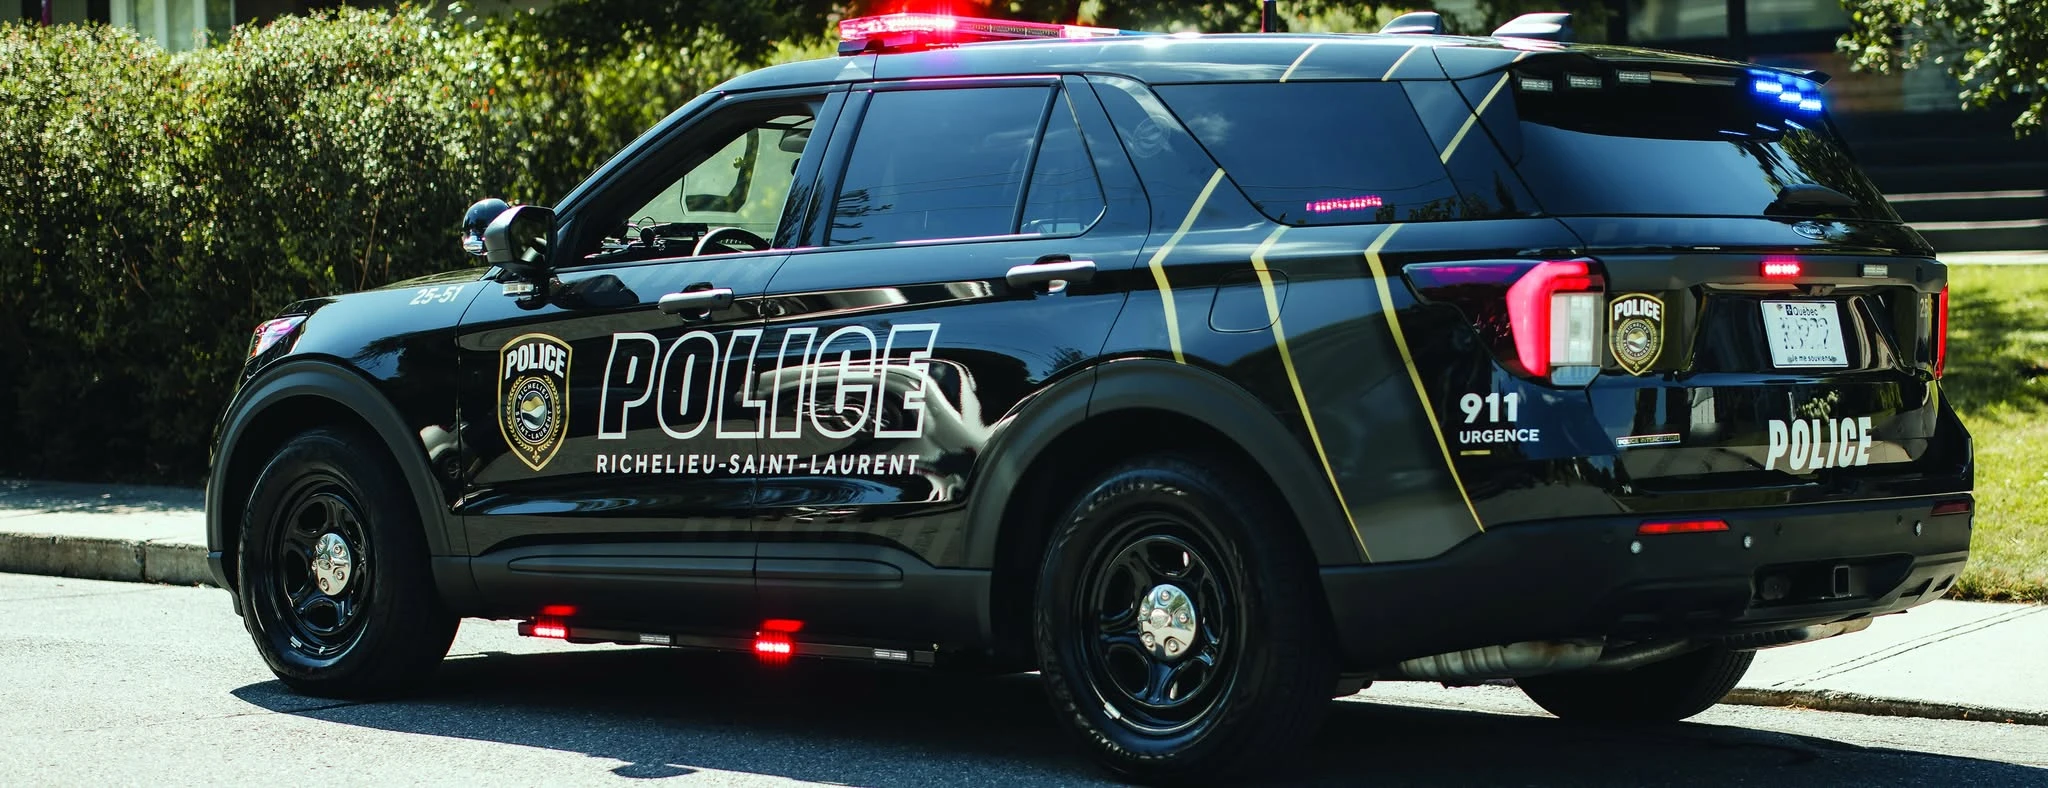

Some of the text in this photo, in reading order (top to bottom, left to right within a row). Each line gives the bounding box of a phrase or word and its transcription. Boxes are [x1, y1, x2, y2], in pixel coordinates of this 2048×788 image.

[409, 285, 464, 305] 25-51
[1614, 299, 1660, 322] POLICE
[1792, 305, 1818, 316] Québec
[505, 343, 567, 380] POLICE
[518, 382, 549, 400] RICHELIEU
[598, 323, 941, 439] POLICE
[1460, 392, 1518, 424] 911
[515, 410, 552, 440] SAINT-LAURENT
[1460, 428, 1540, 443] URGENCE
[1765, 416, 1872, 470] POLICE
[596, 454, 920, 475] RICHELIEU-SAINT-LAURENT
